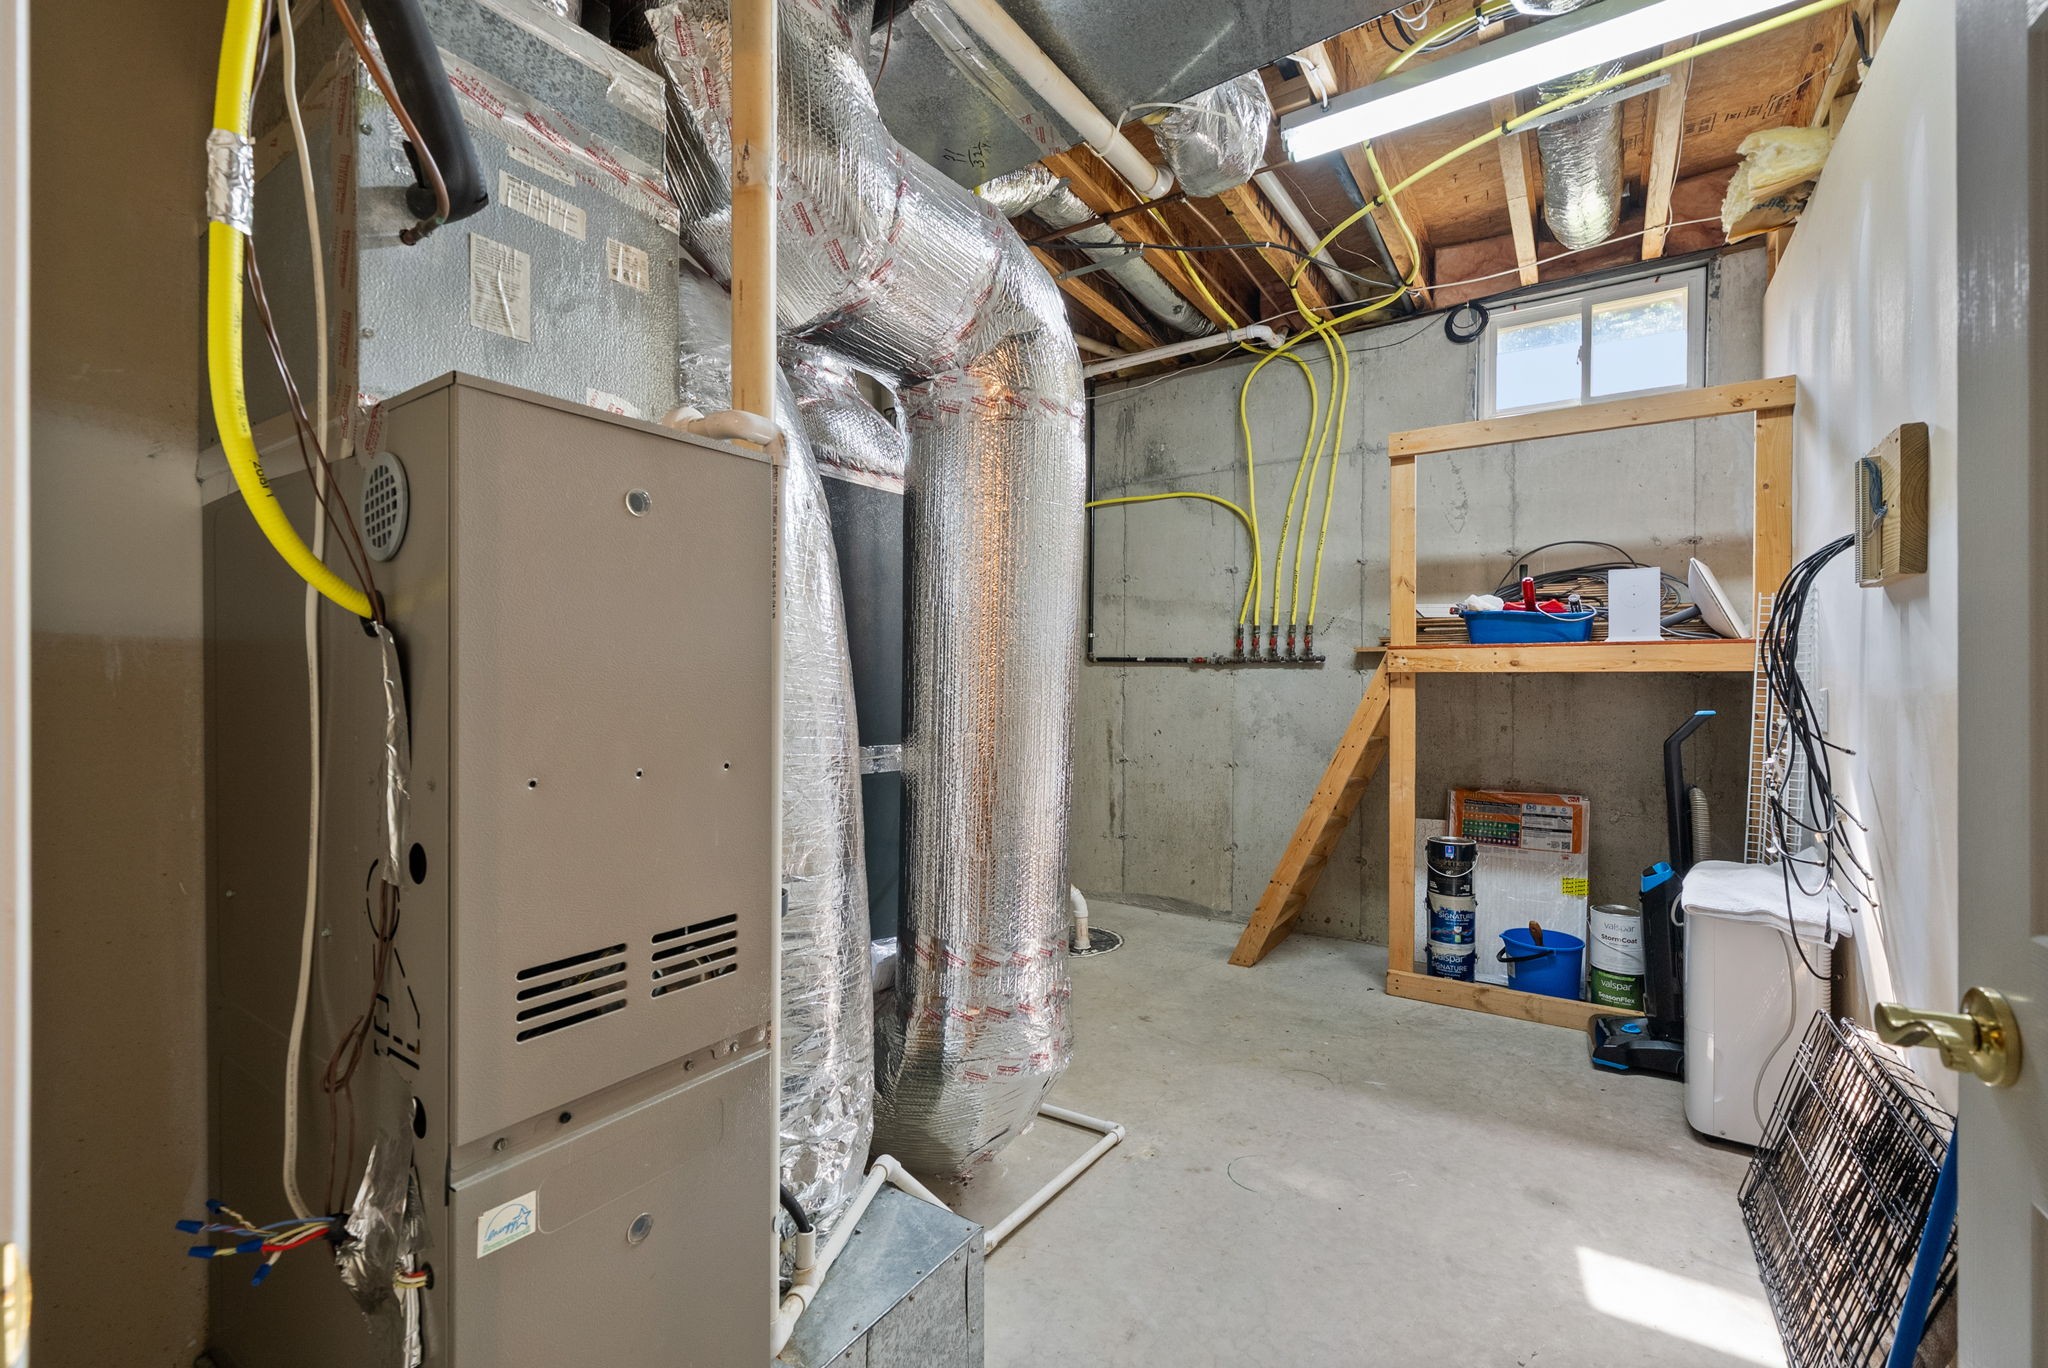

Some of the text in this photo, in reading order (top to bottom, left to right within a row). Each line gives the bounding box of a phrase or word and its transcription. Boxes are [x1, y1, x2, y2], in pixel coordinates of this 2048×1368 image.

[1438, 911, 1474, 920] SIGNATURE
[1604, 922, 1635, 933] valspar
[1601, 934, 1638, 944] StormCoat
[1432, 961, 1469, 972] SIGNATURE
[1600, 979, 1633, 991] valspar
[1598, 991, 1635, 1004] SeasonFlex
